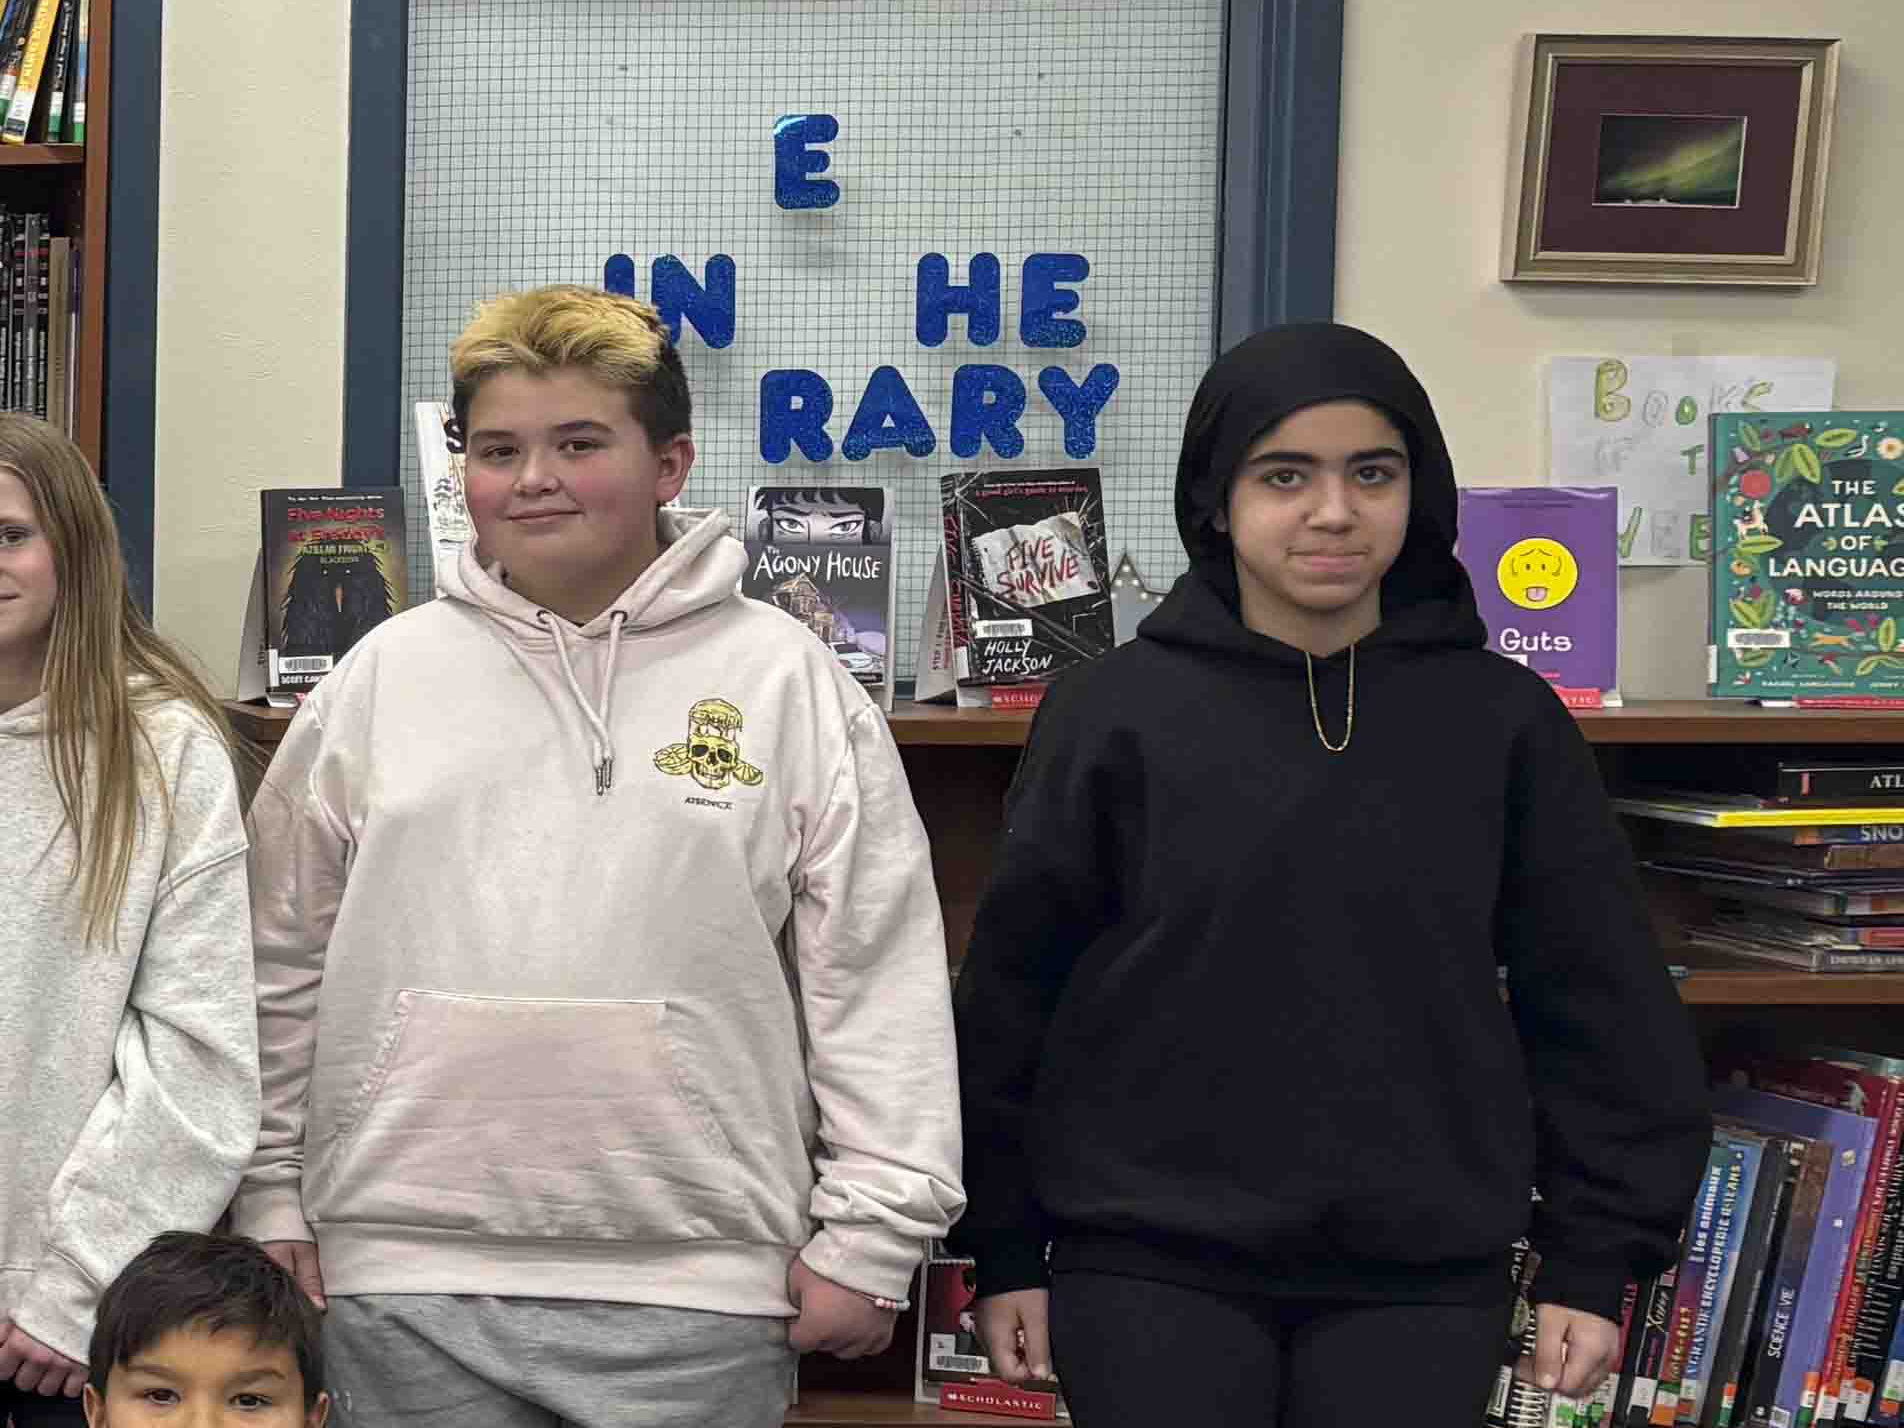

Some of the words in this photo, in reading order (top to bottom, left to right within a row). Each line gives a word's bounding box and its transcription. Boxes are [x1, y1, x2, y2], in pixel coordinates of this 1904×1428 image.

[774, 114, 839, 210] E
[759, 363, 1119, 463] RARY
[1831, 480, 1877, 495] THE
[1007, 535, 1054, 570] FIVE
[1840, 535, 1873, 551] OF
[825, 553, 881, 581] HOUSE
[996, 554, 1080, 596] SURVIVE
[984, 638, 1032, 656] HOLLY
[1499, 627, 1573, 653] Guts
[982, 655, 1053, 676] JACKSON
[1696, 1165, 1723, 1230] animaux
[1777, 1285, 1796, 1308] VIE
[1766, 1308, 1791, 1359] SCIENCE
